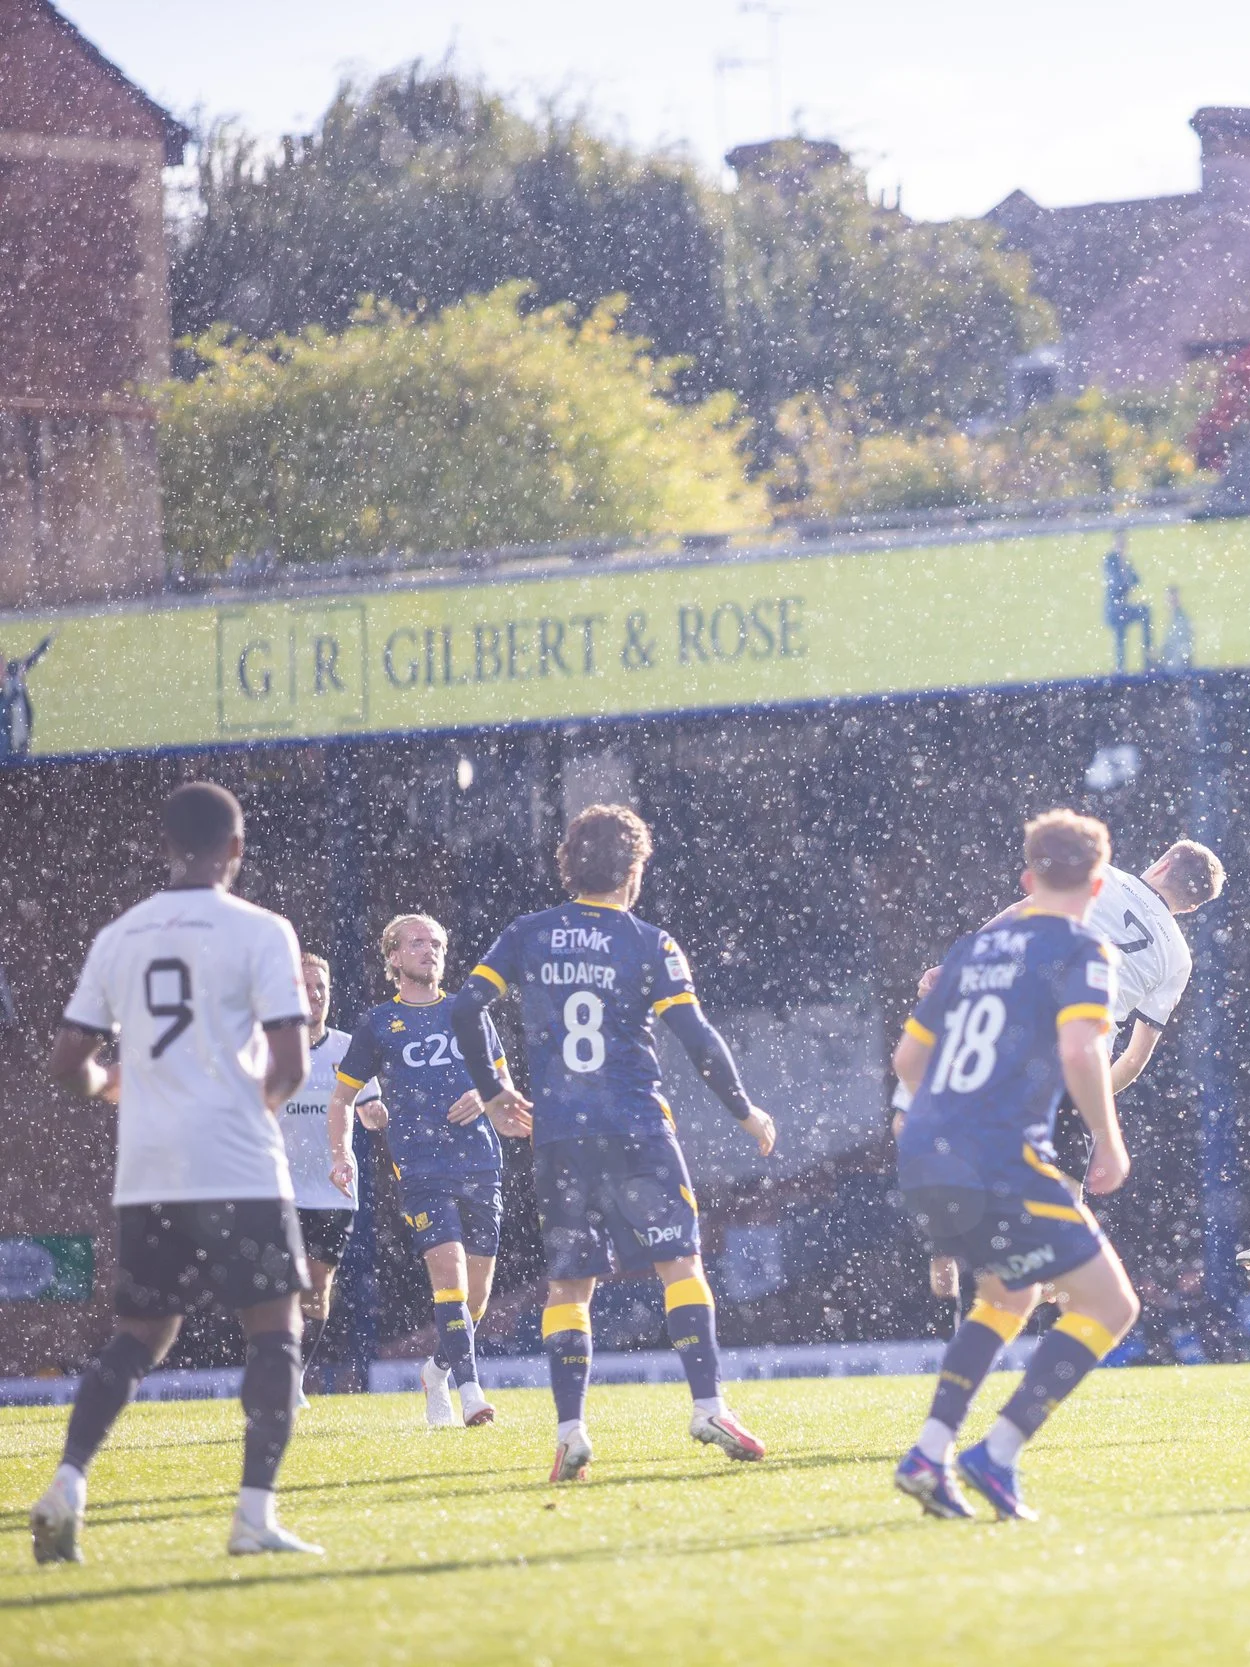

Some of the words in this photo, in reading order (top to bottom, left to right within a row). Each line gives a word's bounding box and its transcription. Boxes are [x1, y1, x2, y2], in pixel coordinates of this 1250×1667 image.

[382, 612, 603, 692] GILBERT
[619, 611, 657, 671] &
[677, 597, 806, 667] ROSE
[551, 928, 613, 954] BTMK
[144, 957, 194, 1060] 9
[563, 990, 606, 1073] 8
[930, 994, 1007, 1095] 18
